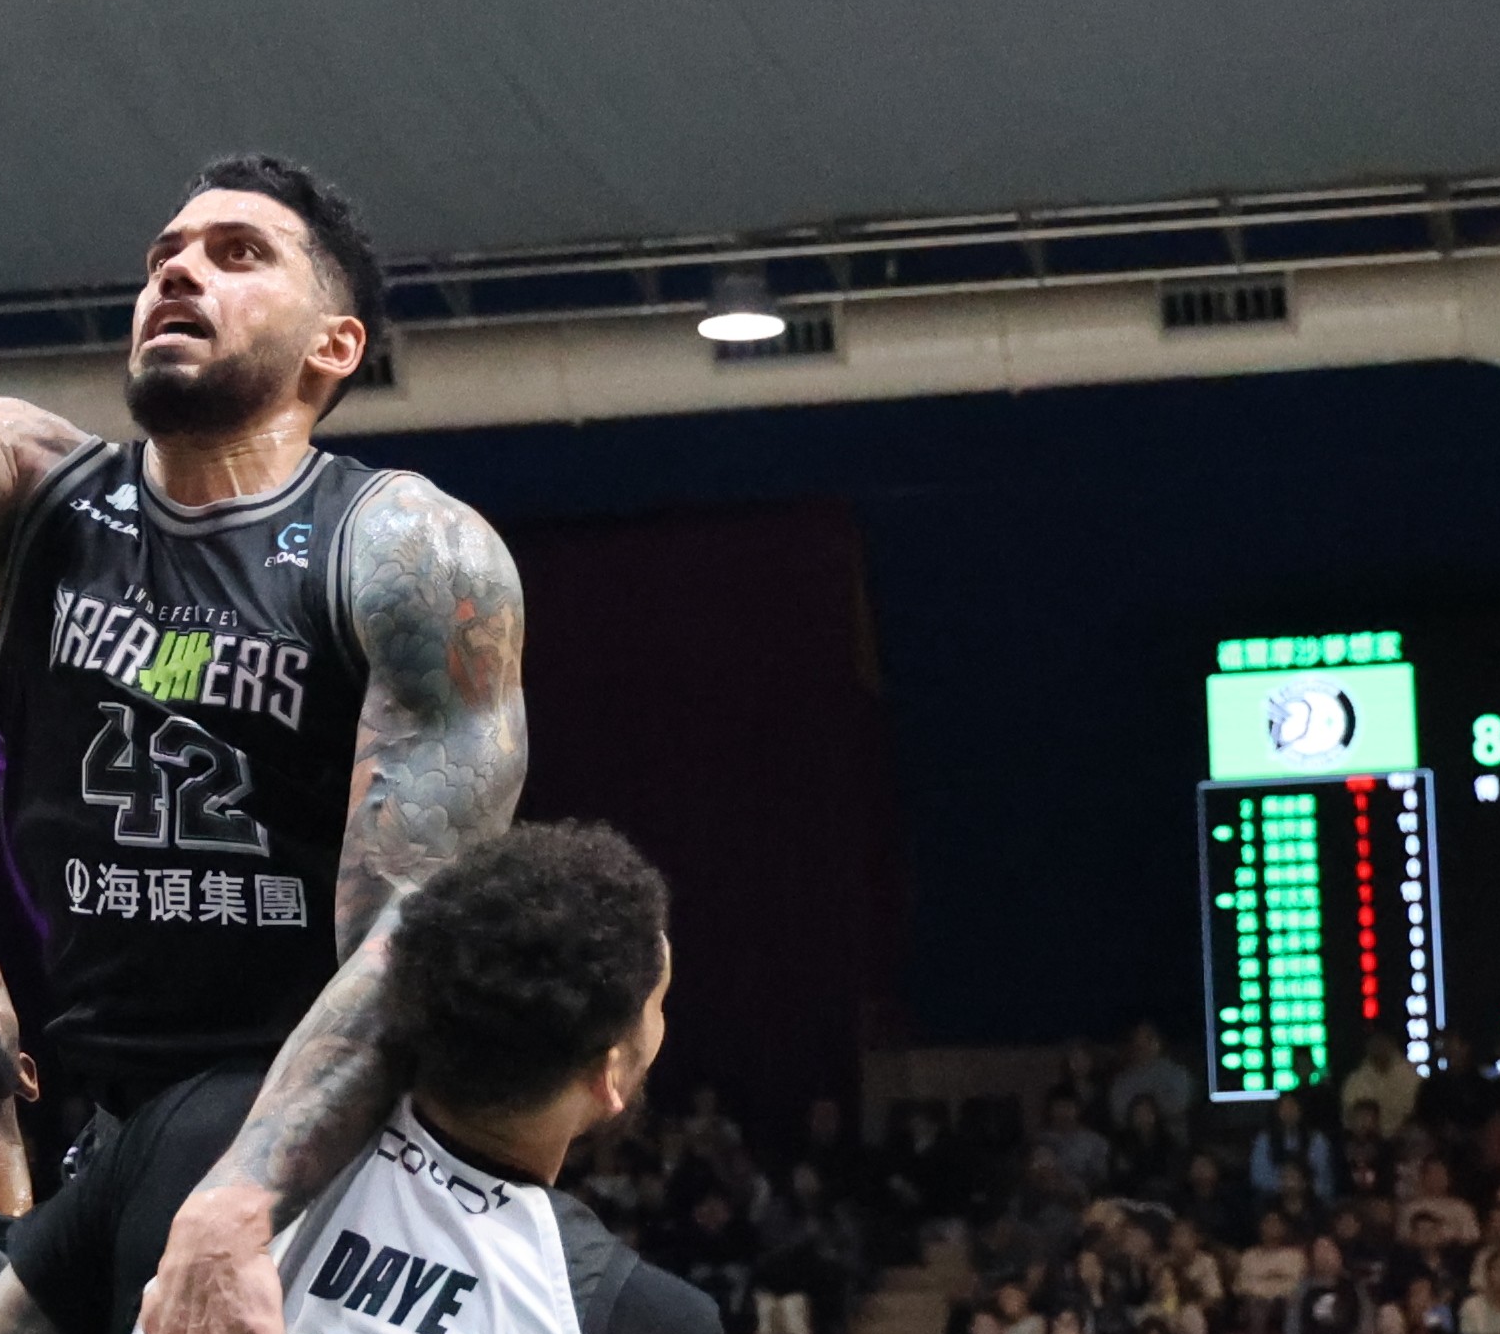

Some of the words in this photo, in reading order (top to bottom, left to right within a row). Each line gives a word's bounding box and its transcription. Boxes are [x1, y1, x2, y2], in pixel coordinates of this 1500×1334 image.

[82, 702, 270, 857] 42
[96, 861, 308, 928] 海碩集團
